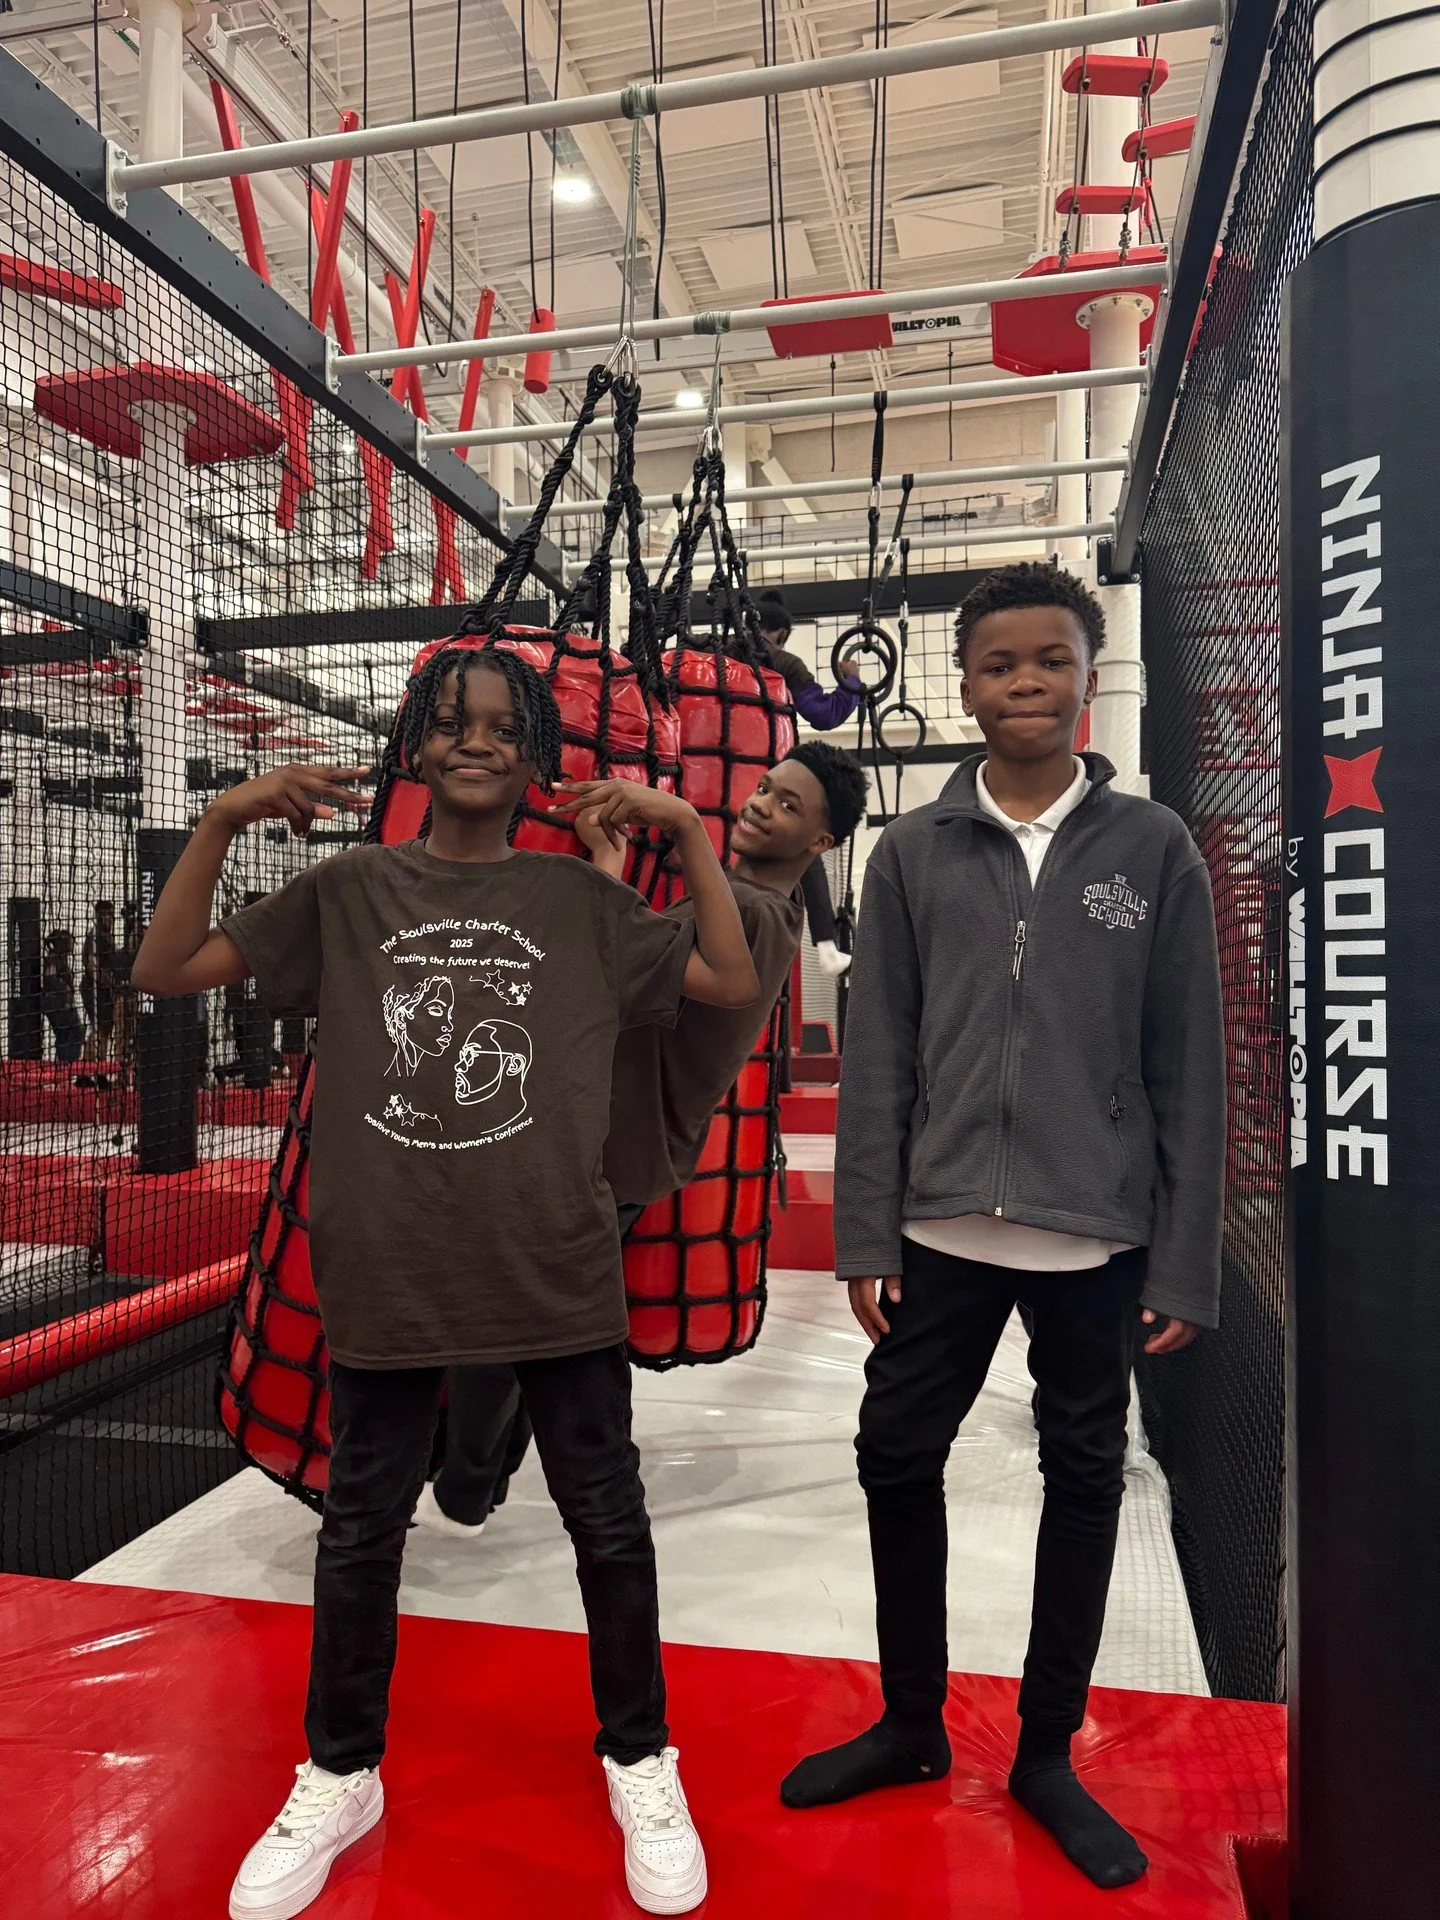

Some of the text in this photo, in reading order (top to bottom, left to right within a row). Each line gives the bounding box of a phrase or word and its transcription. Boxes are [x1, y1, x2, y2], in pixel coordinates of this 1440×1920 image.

[1321, 455, 1388, 1186] NINJA COURSE
[1083, 883, 1148, 920] SOULSVILLE
[1088, 903, 1136, 929] SCHOOL
[380, 918, 546, 961] The Soulsville Charter School
[450, 939, 473, 948] 2025
[393, 954, 426, 965] Creating
[430, 955, 445, 965] the
[447, 956, 478, 967] future
[1284, 837, 1307, 1169] by WALLTOPIA
[364, 1113, 534, 1150] Positive Young Men's and Women's Conference
